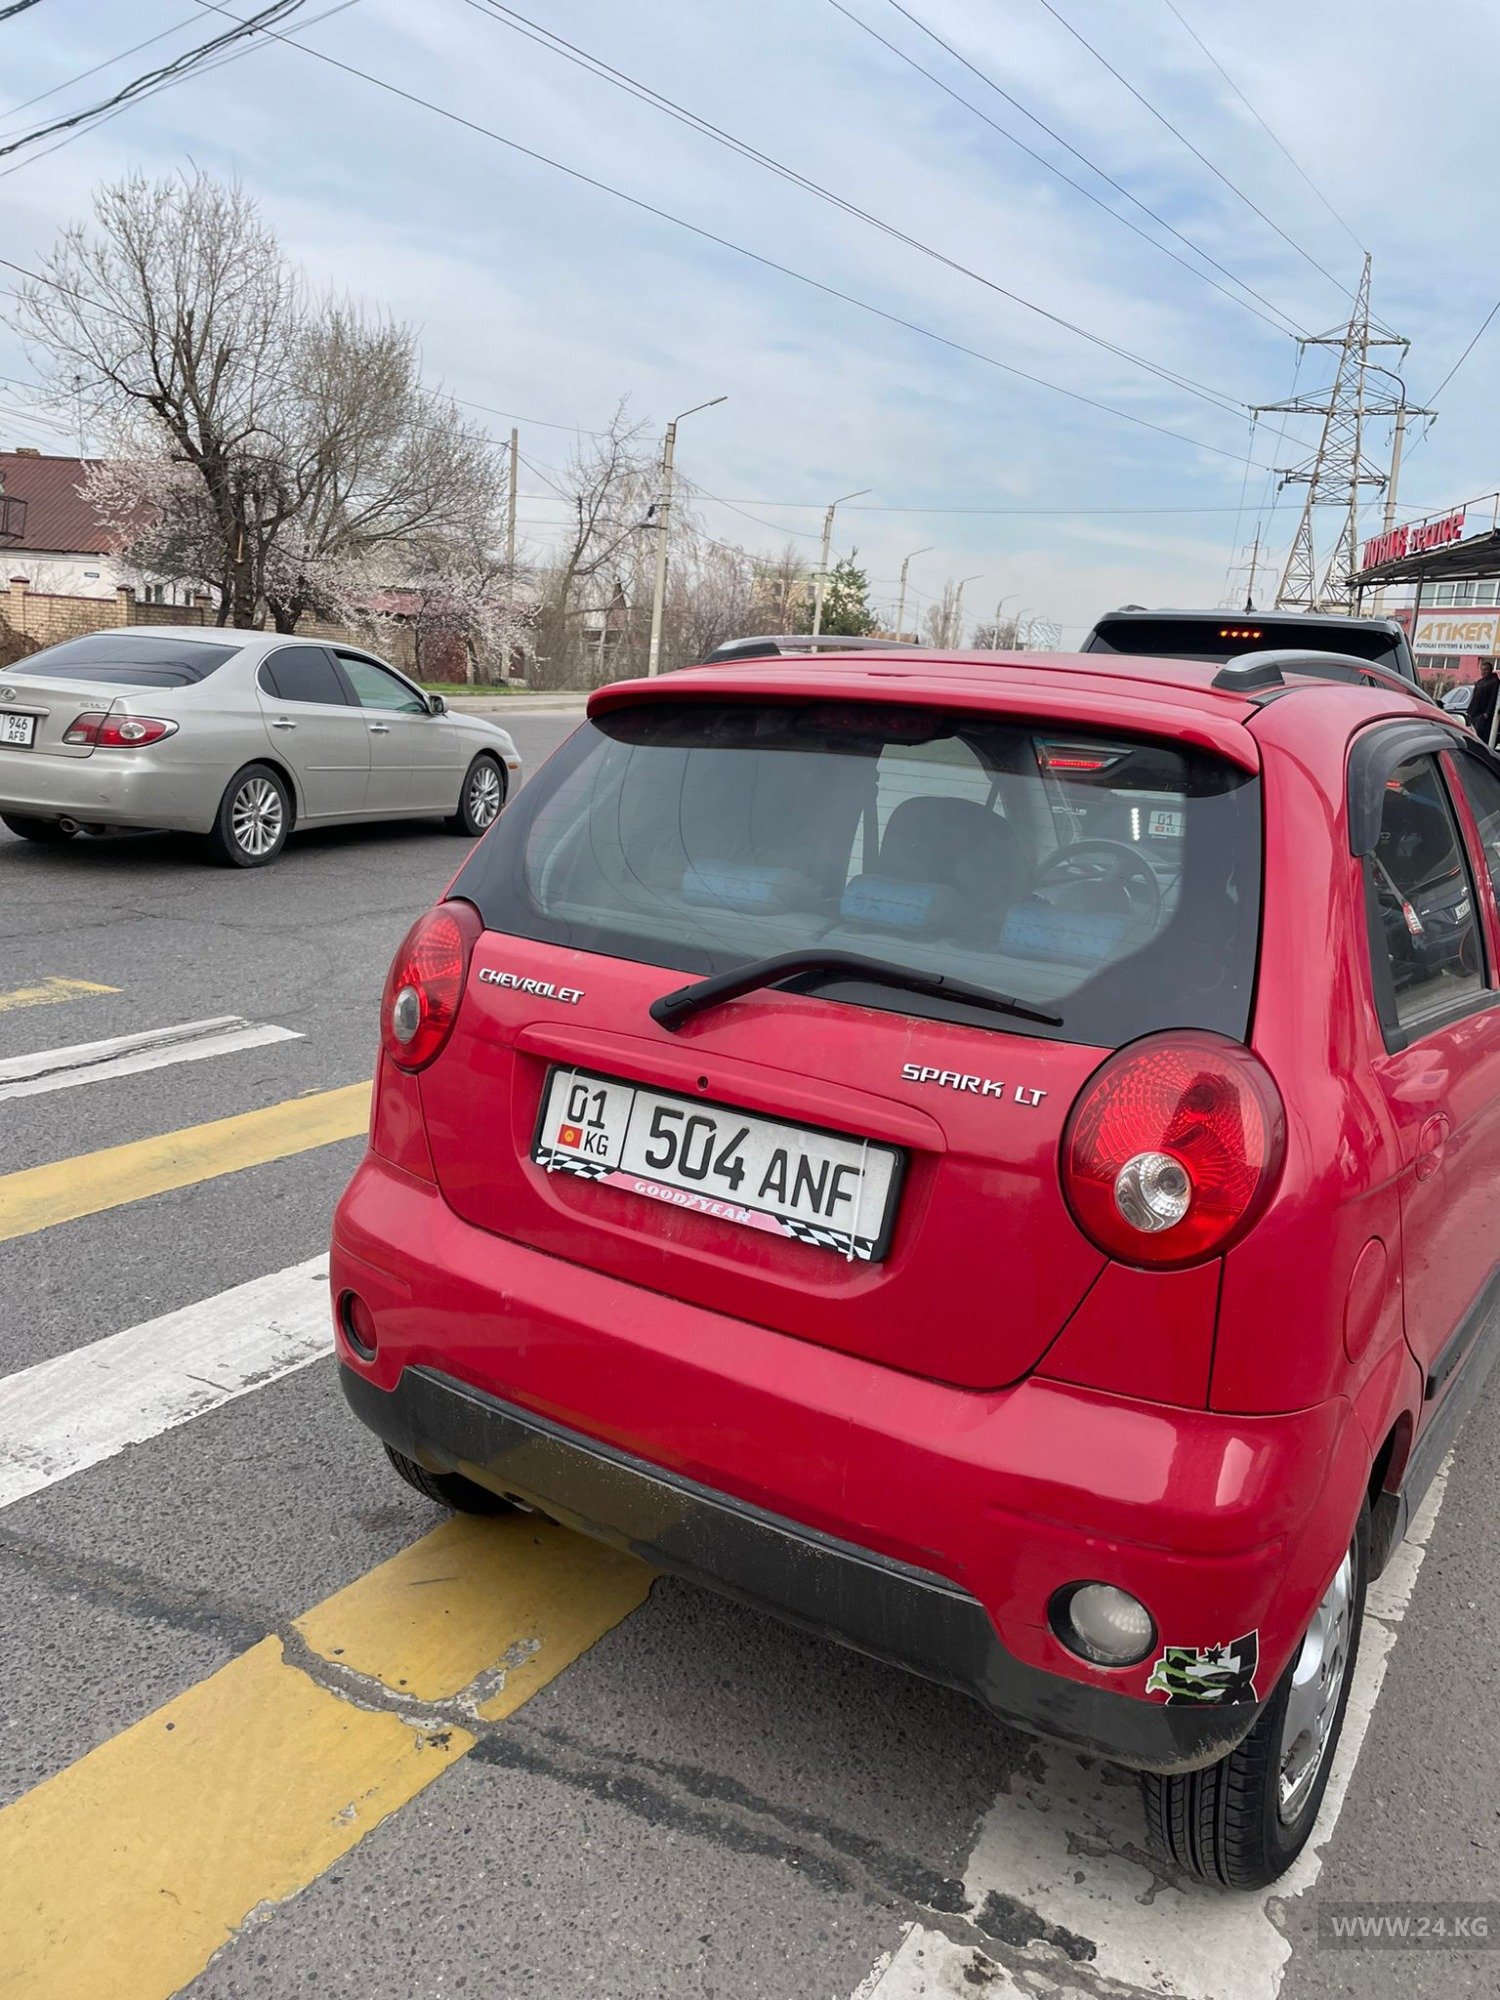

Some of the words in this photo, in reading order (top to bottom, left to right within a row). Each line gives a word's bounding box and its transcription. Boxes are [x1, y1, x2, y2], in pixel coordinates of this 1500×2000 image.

[8, 730, 26, 742] AFB
[9, 716, 28, 730] 946
[1158, 813, 1173, 826] 01
[479, 967, 585, 1005] CHEVROLET
[901, 1063, 1005, 1098] SPARK
[1014, 1085, 1048, 1107] LT
[567, 1084, 608, 1130] 01
[583, 1130, 609, 1157] KG
[645, 1105, 751, 1191] 504
[757, 1148, 865, 1218] ANF
[634, 1181, 751, 1223] GOODYEAR
